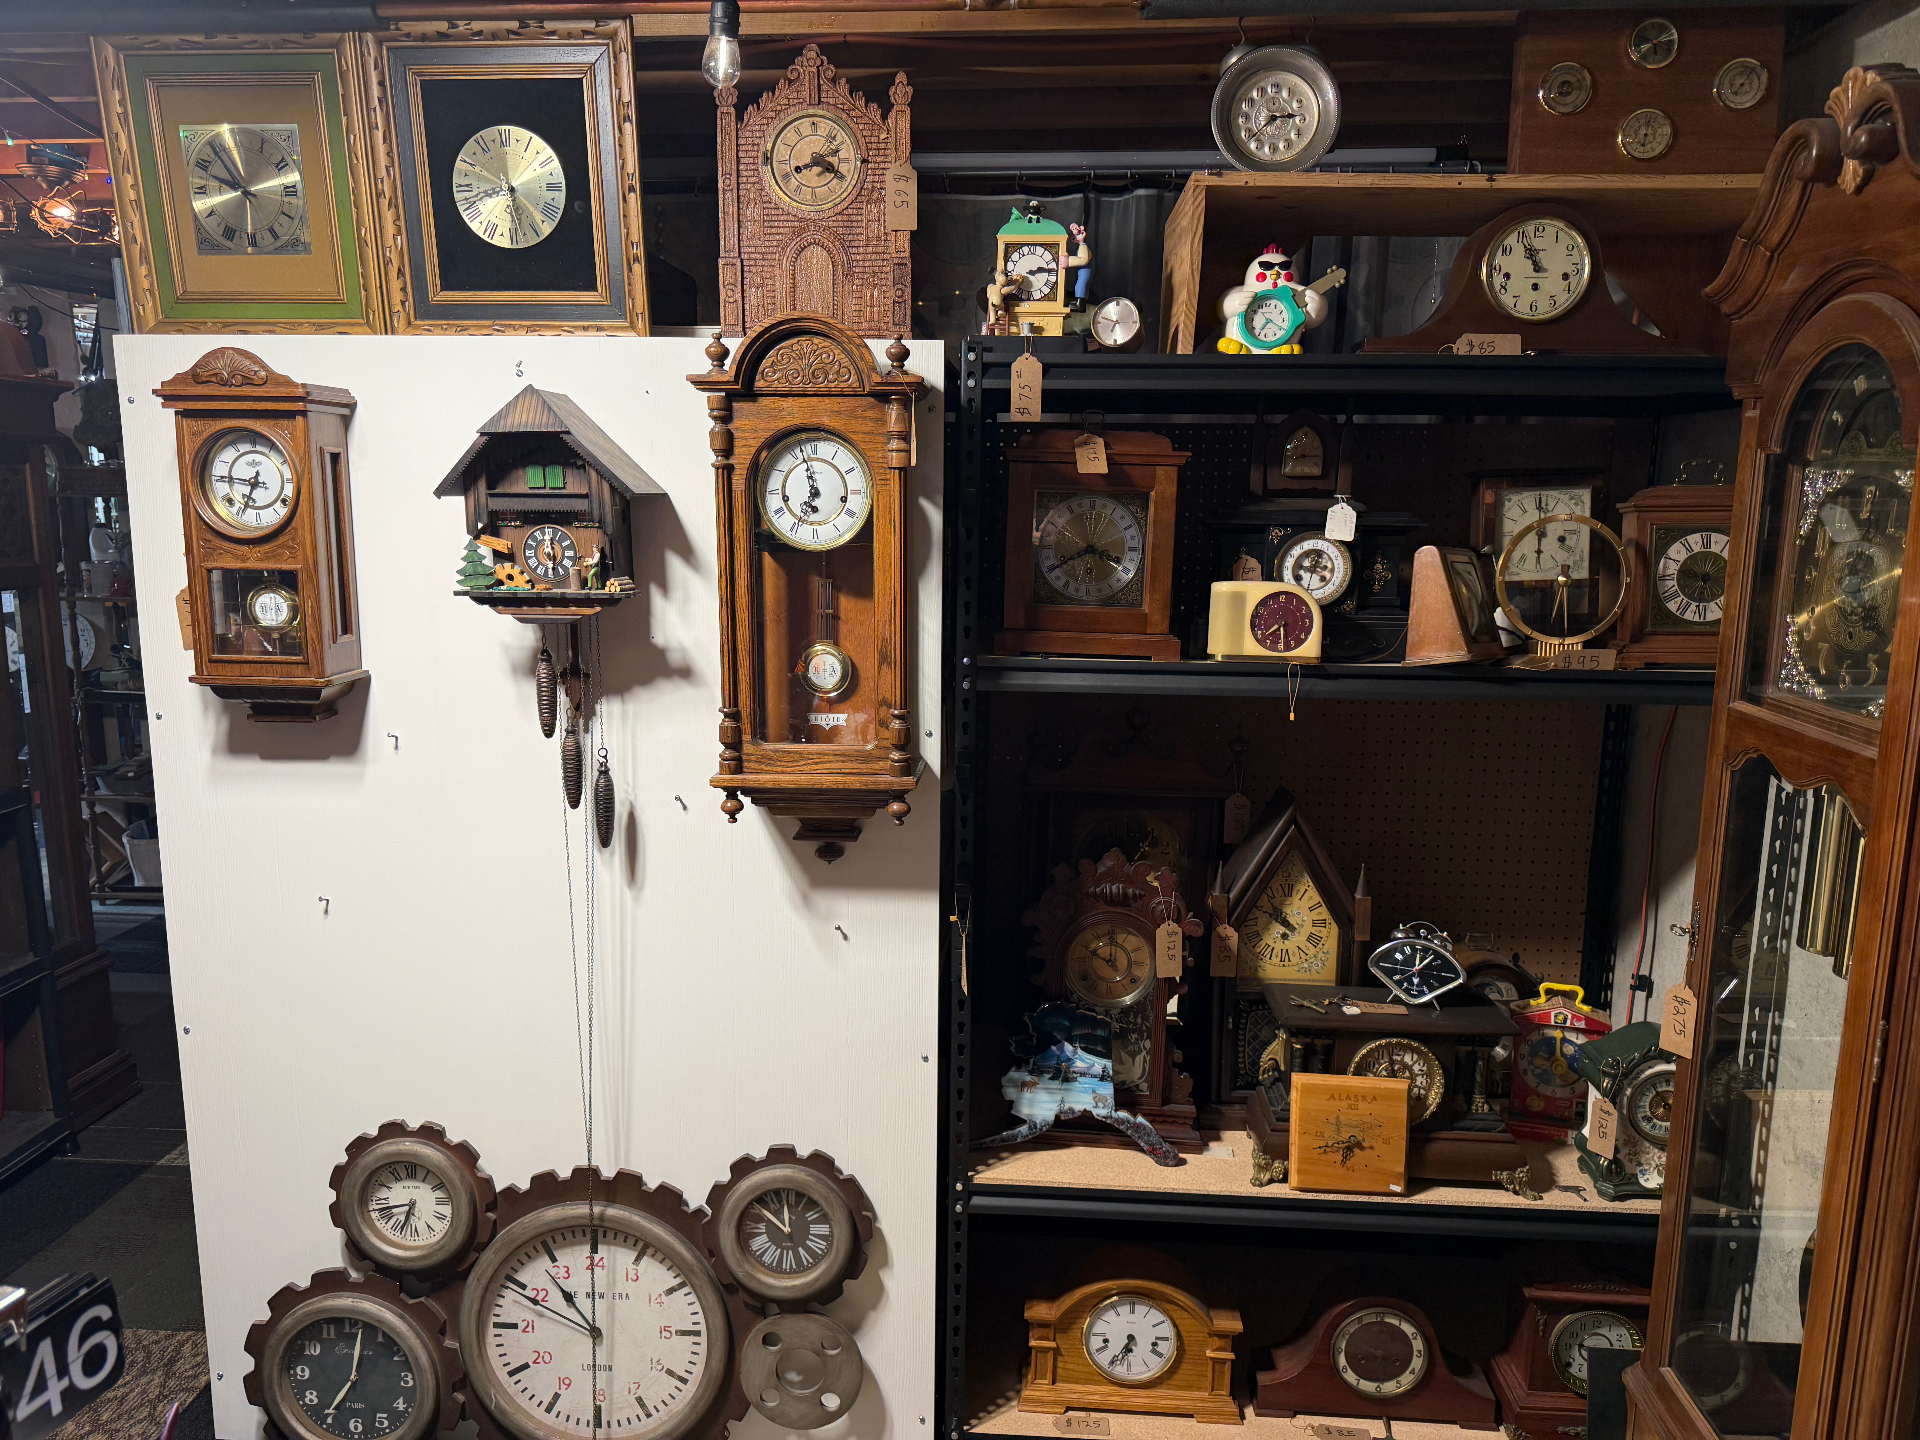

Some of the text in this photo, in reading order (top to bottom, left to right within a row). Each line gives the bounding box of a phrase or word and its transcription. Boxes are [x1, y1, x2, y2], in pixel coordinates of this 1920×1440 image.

[474, 134, 491, 156] XI
[497, 129, 511, 148] XII
[459, 156, 477, 170] X
[539, 155, 555, 169] II
[455, 182, 473, 193] IX
[546, 182, 562, 192] III
[462, 201, 482, 223] VIII
[540, 201, 561, 222] IIII
[483, 220, 499, 240] VII
[529, 221, 540, 238] V
[1534, 225, 1546, 239] 12
[1555, 230, 1559, 244] 1
[1500, 243, 1513, 257] 10
[1566, 243, 1575, 257] 2
[1493, 263, 1502, 276] 9
[1571, 263, 1580, 276] 3
[1499, 281, 1508, 295] 8
[1562, 281, 1573, 295] 4
[1512, 295, 1521, 309] 7
[1529, 299, 1538, 313] 6
[1549, 295, 1557, 308] 5
[1463, 339, 1496, 355] $85
[1561, 653, 1600, 669] $95
[1167, 929, 1179, 961] $125
[1671, 994, 1692, 1039] $275
[1325, 1093, 1378, 1105] ALASKA
[585, 1255, 607, 1271] 24
[553, 1265, 571, 1280] 23
[625, 1267, 640, 1283] 13
[531, 1287, 549, 1303] 22
[585, 1291, 605, 1300] NEW
[612, 1292, 630, 1301] ERA
[648, 1292, 664, 1308] 14
[322, 1324, 336, 1338] 11
[343, 1319, 364, 1333] 12
[521, 1318, 535, 1334] 21
[659, 1325, 673, 1340] 15
[376, 1327, 384, 1342] 1
[303, 1341, 321, 1355] 10
[393, 1346, 406, 1361] 2
[15, 1304, 119, 1423] 46
[531, 1350, 553, 1365] 20
[650, 1357, 665, 1373] 16
[296, 1366, 310, 1380] 9
[581, 1362, 613, 1372] LODON
[400, 1372, 414, 1387] 3
[557, 1376, 573, 1391] 19
[627, 1381, 641, 1396] 17
[304, 1390, 318, 1405] 8
[393, 1396, 407, 1411] 4
[323, 1409, 337, 1424] 7
[375, 1413, 389, 1427] 5
[1065, 1418, 1101, 1428] $125
[349, 1418, 363, 1433] 6
